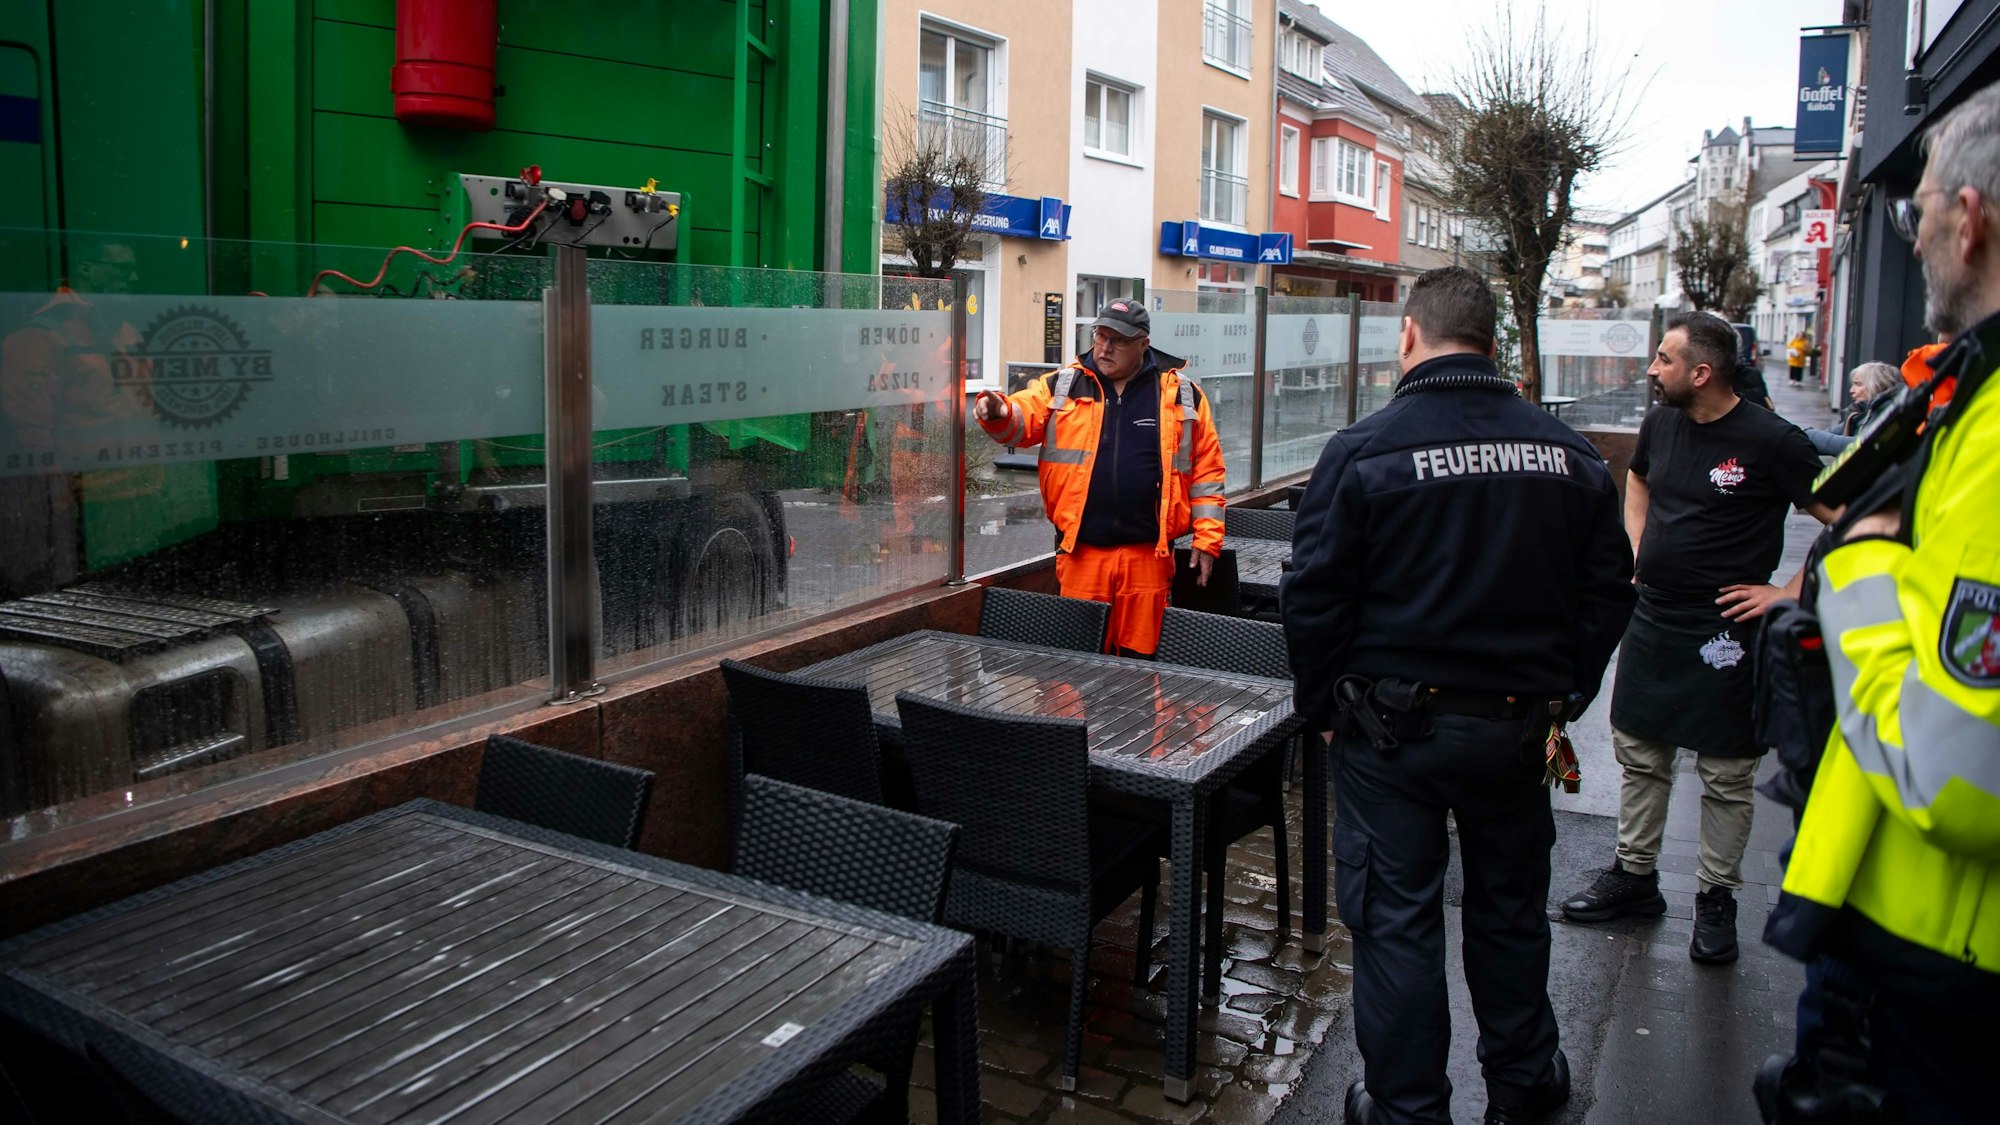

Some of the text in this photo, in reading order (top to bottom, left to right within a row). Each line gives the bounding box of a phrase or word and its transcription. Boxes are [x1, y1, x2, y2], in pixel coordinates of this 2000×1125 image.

[1800, 85, 1844, 103] Gaffel
[1041, 218, 1060, 235] AXA
[1259, 248, 1282, 260] AXA
[1412, 443, 1569, 480] FEUERWEHR
[1709, 467, 1746, 487] Memo
